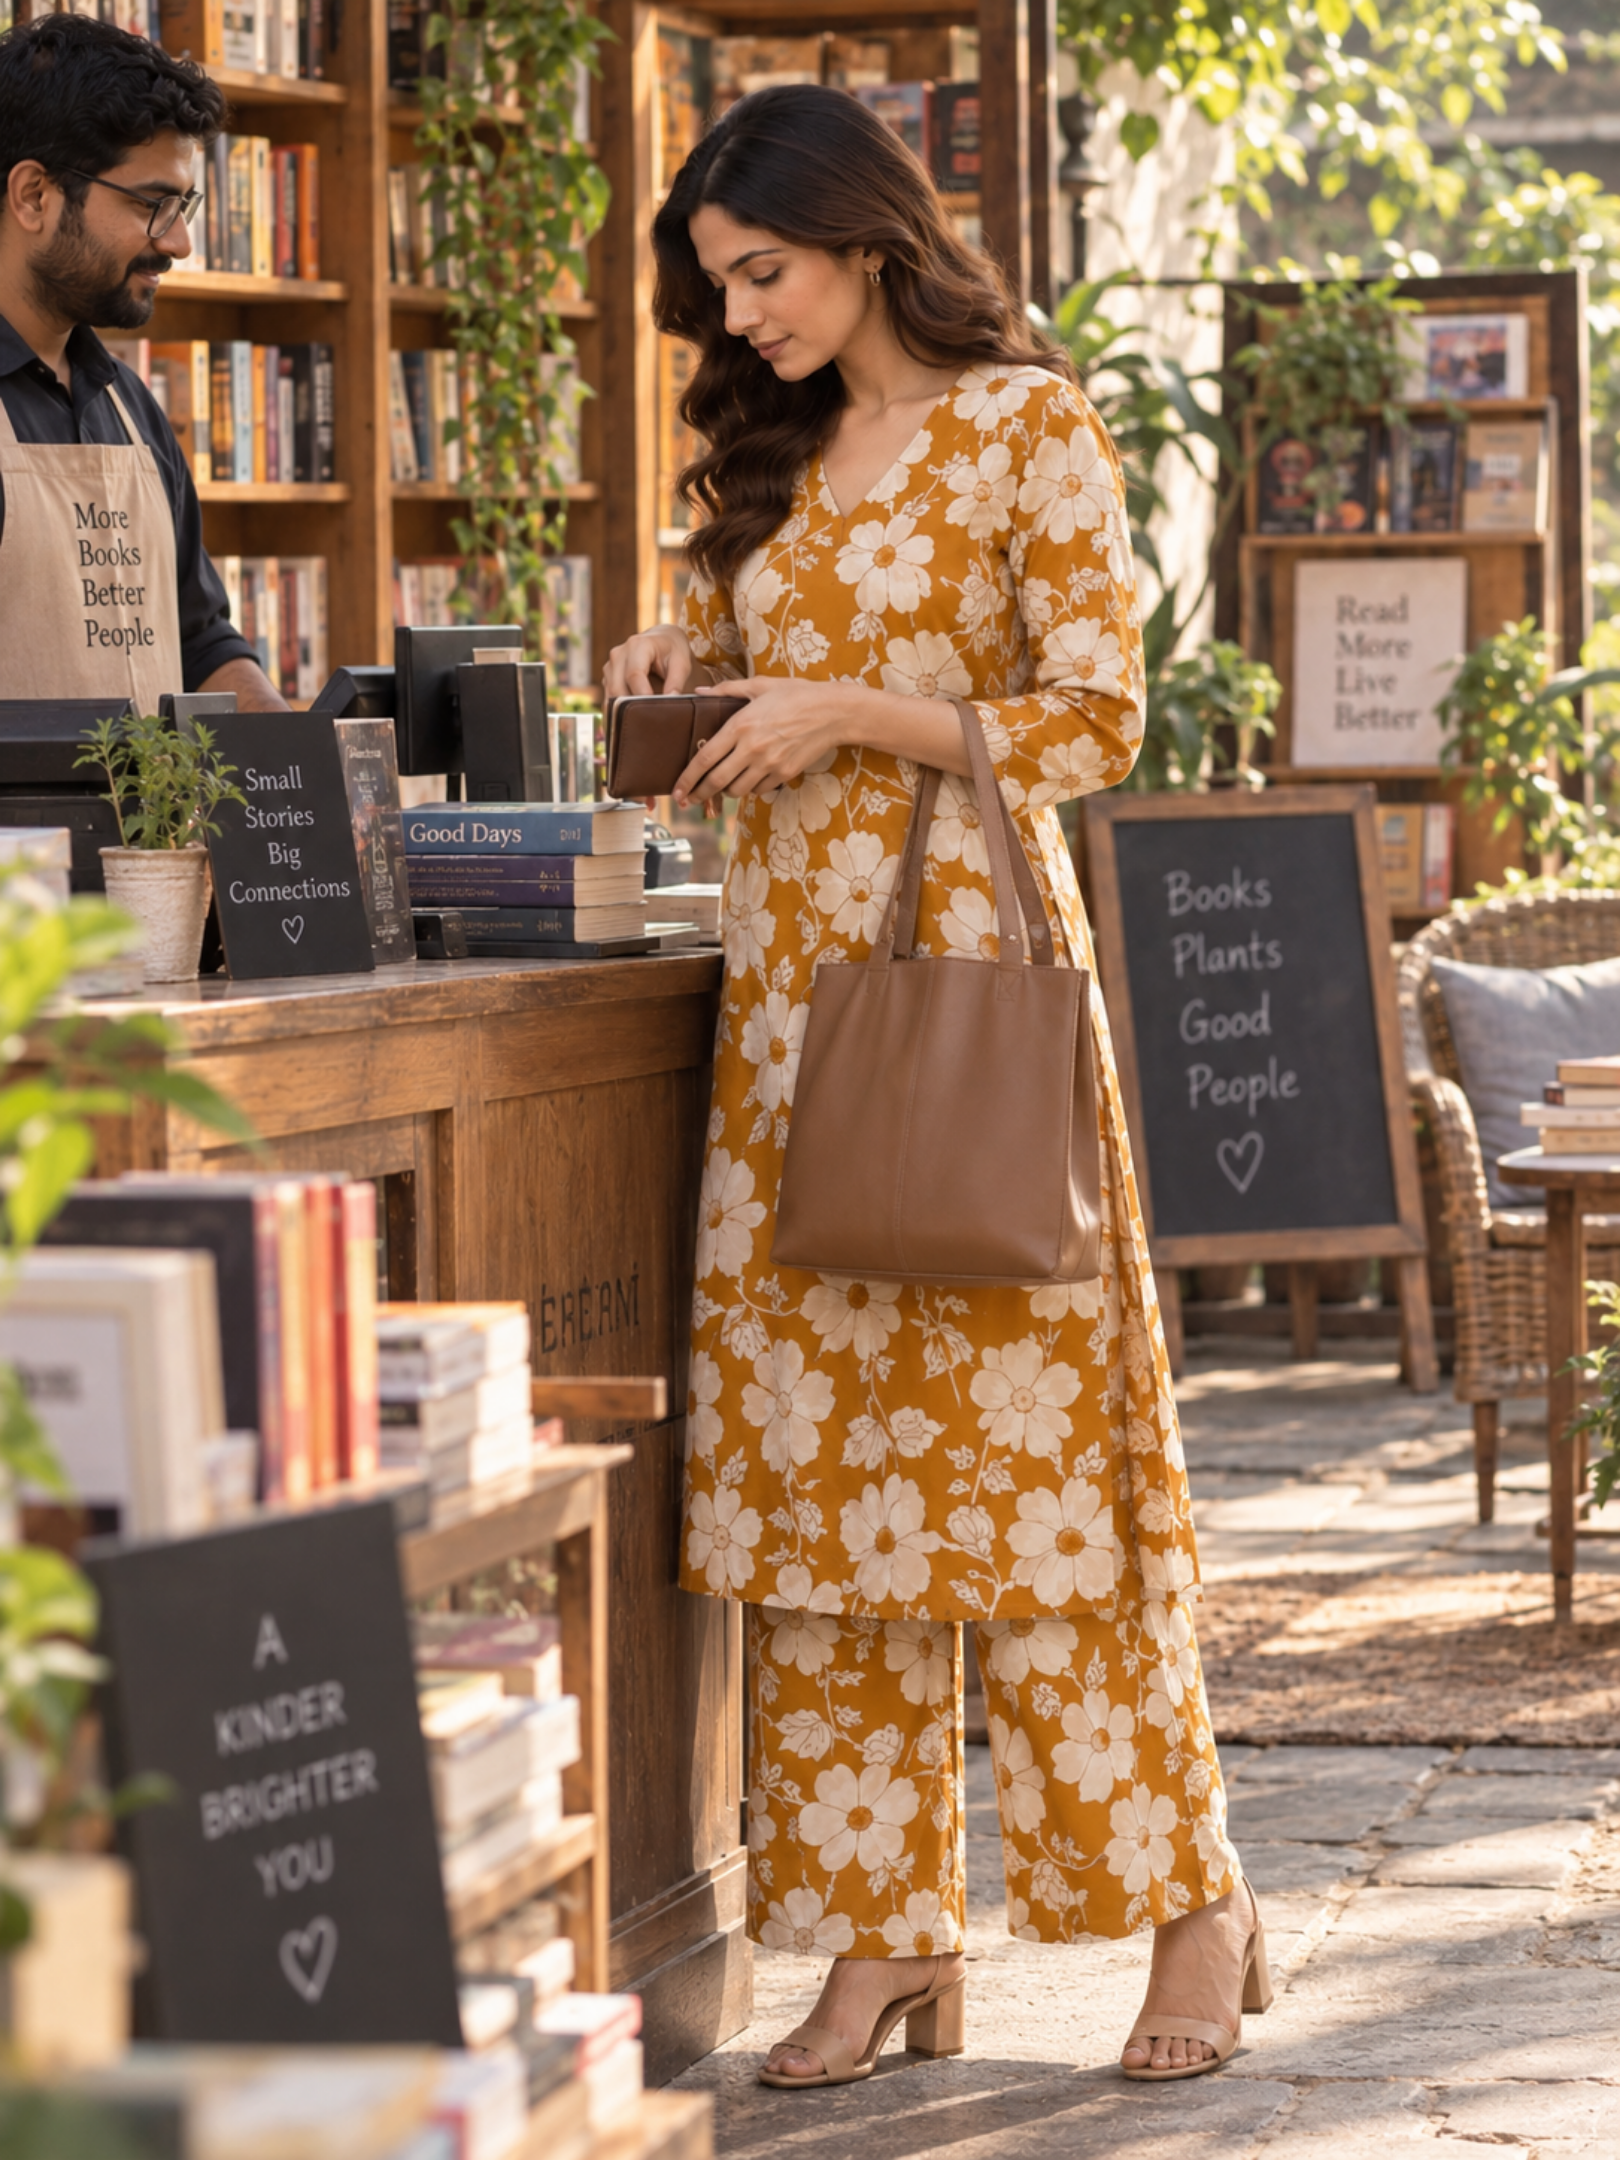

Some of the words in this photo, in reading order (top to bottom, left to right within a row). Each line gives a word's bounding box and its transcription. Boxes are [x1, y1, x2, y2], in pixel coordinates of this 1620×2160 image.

[73, 502, 129, 529] More
[78, 538, 141, 567] Books
[81, 578, 145, 607] Better
[1336, 593, 1409, 625] Read
[84, 617, 155, 655] People
[1335, 631, 1411, 660] More
[1336, 666, 1396, 696] Live
[1334, 701, 1420, 731] Better
[245, 765, 303, 792] Small
[245, 805, 315, 829] Stories
[409, 822, 465, 844] Good
[471, 822, 523, 848] Days
[267, 842, 302, 870] Big
[229, 877, 351, 904] Connections
[1164, 865, 1272, 917] Books
[1171, 930, 1284, 979] Plants
[1179, 989, 1272, 1045] Good
[1186, 1055, 1301, 1118] People
[253, 1611, 290, 1671] A
[213, 1679, 349, 1758] KINDER
[200, 1746, 380, 1841] BRIGHTER
[253, 1833, 335, 1899] YOU
